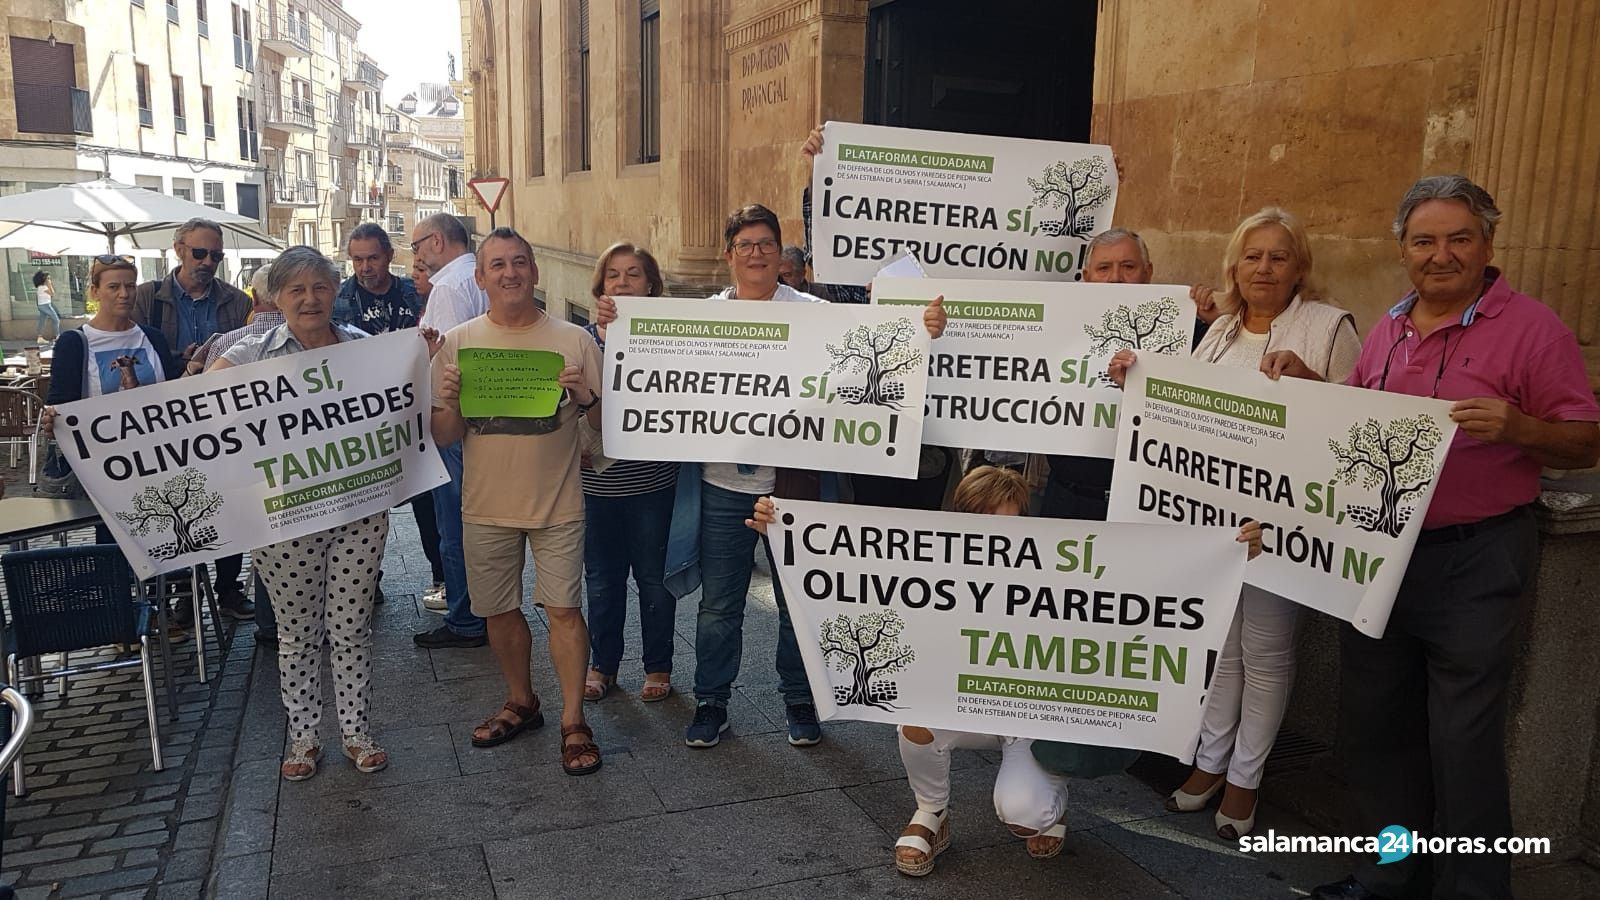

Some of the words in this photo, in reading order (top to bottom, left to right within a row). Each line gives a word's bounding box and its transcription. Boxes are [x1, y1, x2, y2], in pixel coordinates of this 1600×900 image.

[845, 149, 918, 164] PLATAFORMA
[921, 155, 987, 170] CIUDADANA
[847, 164, 873, 173] DEFENSA
[921, 171, 946, 179] PAREDES
[956, 174, 977, 182] PIEDRA
[822, 177, 998, 231] ¡CARRETERA
[1006, 206, 1039, 237] SÍ,
[832, 234, 1028, 271] DESTRUCCIÓN
[637, 322, 710, 335] PLATAFORMA
[713, 325, 782, 338] CIUDADANA
[964, 306, 1036, 319] CIUDADANA
[612, 352, 791, 398] ¡CARRETERA
[799, 371, 836, 404] SÍ,
[926, 354, 1051, 383] RRETERA
[1059, 354, 1098, 389] SÍ,
[65, 374, 299, 460] ¡CARRETERA
[302, 359, 344, 394] SÍ,
[1094, 403, 1118, 429] N
[1145, 401, 1152, 409] EN
[1153, 403, 1173, 414] DEFENSA
[1181, 410, 1190, 418] LOS
[1191, 412, 1210, 423] OLIVOS
[1210, 416, 1214, 424] Y
[1214, 418, 1238, 430] PAREDES
[1239, 424, 1247, 432] DE
[1247, 425, 1268, 437] PIEDRA
[1270, 430, 1285, 440] SECA
[1151, 383, 1212, 408] PLATAFORMA
[1214, 397, 1279, 423] CIUDADANA
[103, 426, 243, 481] OLIVOS
[246, 419, 267, 447] Y
[277, 382, 415, 440] PAREDES
[621, 408, 825, 442] DESTRUCCIÓN
[272, 483, 345, 510] PLATAFORMA
[346, 463, 399, 488] CIUDADANA
[1128, 415, 1295, 508] ¡CARRETERA
[1304, 479, 1346, 525] SÍ,
[782, 512, 1042, 571] ¡CARRETERA
[1055, 533, 1106, 580] SÍ,
[1138, 484, 1334, 573] DESTRUCIÓN
[802, 568, 956, 611] OLIVOS
[968, 581, 994, 613] Y
[1006, 584, 1205, 631] PAREDES
[967, 679, 1058, 698] PLATAFORMA
[1062, 688, 1149, 708] CIUDADANA
[969, 697, 1001, 706] DEFENSA
[1030, 703, 1056, 712] OLIVOS
[1063, 706, 1095, 716] PAREDES
[1109, 711, 1136, 720] PIEDRA
[1137, 714, 1157, 723] SECA
[957, 705, 967, 713] DE
[968, 706, 983, 714] SAN
[984, 708, 1016, 718] ESTEBAN
[1018, 711, 1028, 719] DE
[1040, 714, 1065, 723] SIERRA
[1070, 717, 1117, 728] SALAMANCA
